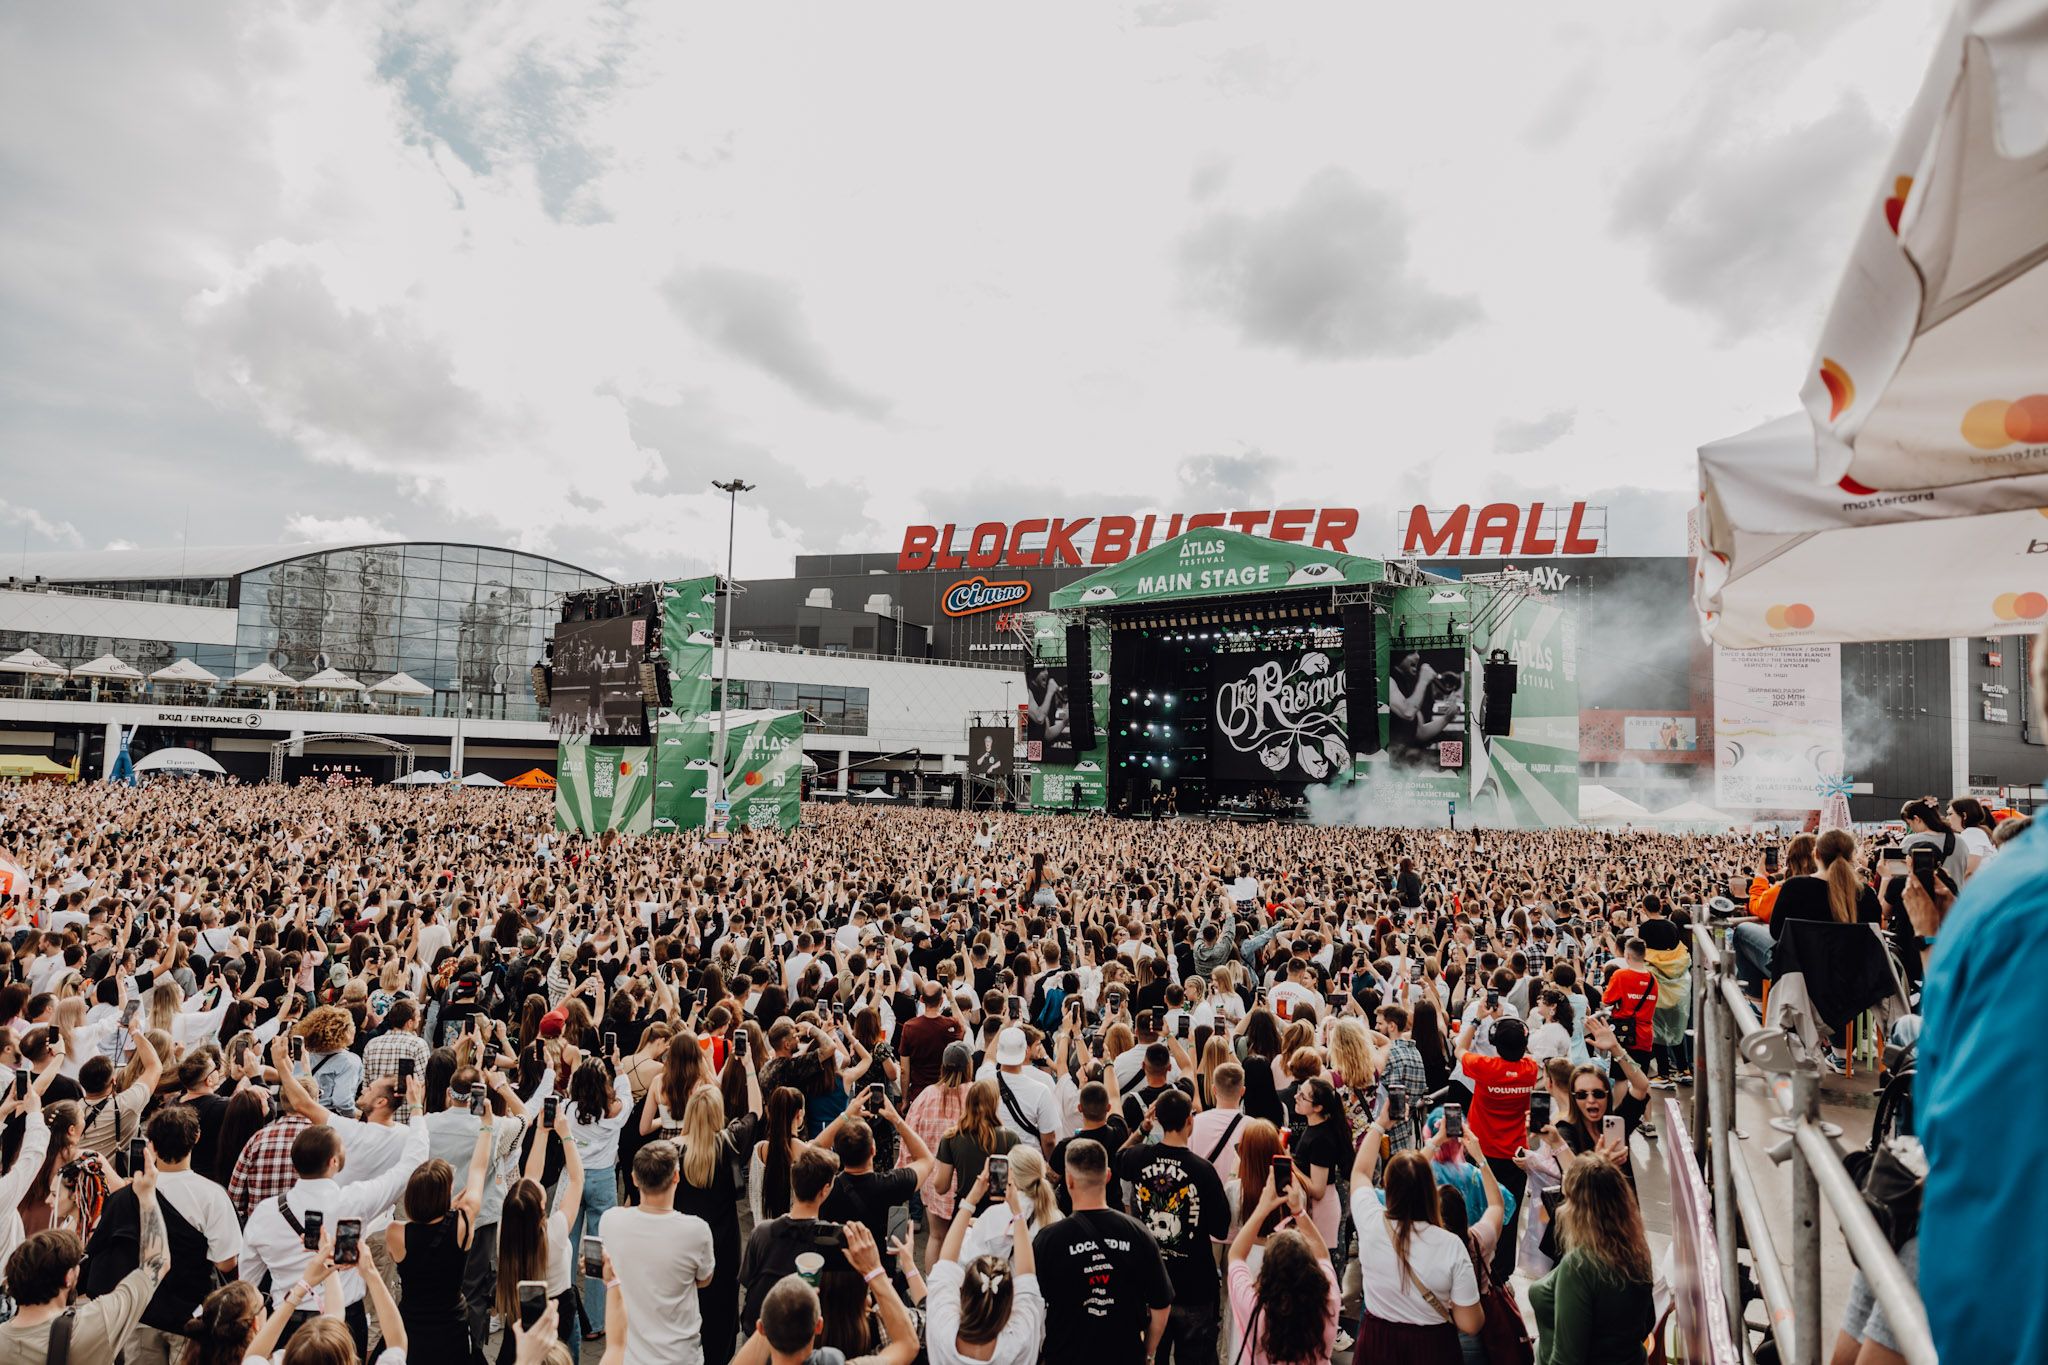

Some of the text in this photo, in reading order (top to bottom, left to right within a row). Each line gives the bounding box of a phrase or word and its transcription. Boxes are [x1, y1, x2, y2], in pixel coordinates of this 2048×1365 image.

[1842, 491, 1935, 512] mastercard
[1402, 502, 1599, 556] MALL
[1179, 556, 1225, 567] FESTIVAL
[1137, 565, 1270, 595] MAIN STAGE
[1532, 566, 1571, 591] AXY
[948, 582, 1025, 611] Сільпо
[969, 643, 1024, 651] ALL STARS
[1248, 661, 1346, 739] Rasmu
[158, 713, 182, 722] ВХІД
[190, 715, 243, 724] ENTRANCE
[312, 763, 361, 773] LAMEL
[1142, 1164, 1188, 1181] THAT
[1187, 1183, 1200, 1227] SHIT
[1069, 1238, 1130, 1255] LOCAED IN
